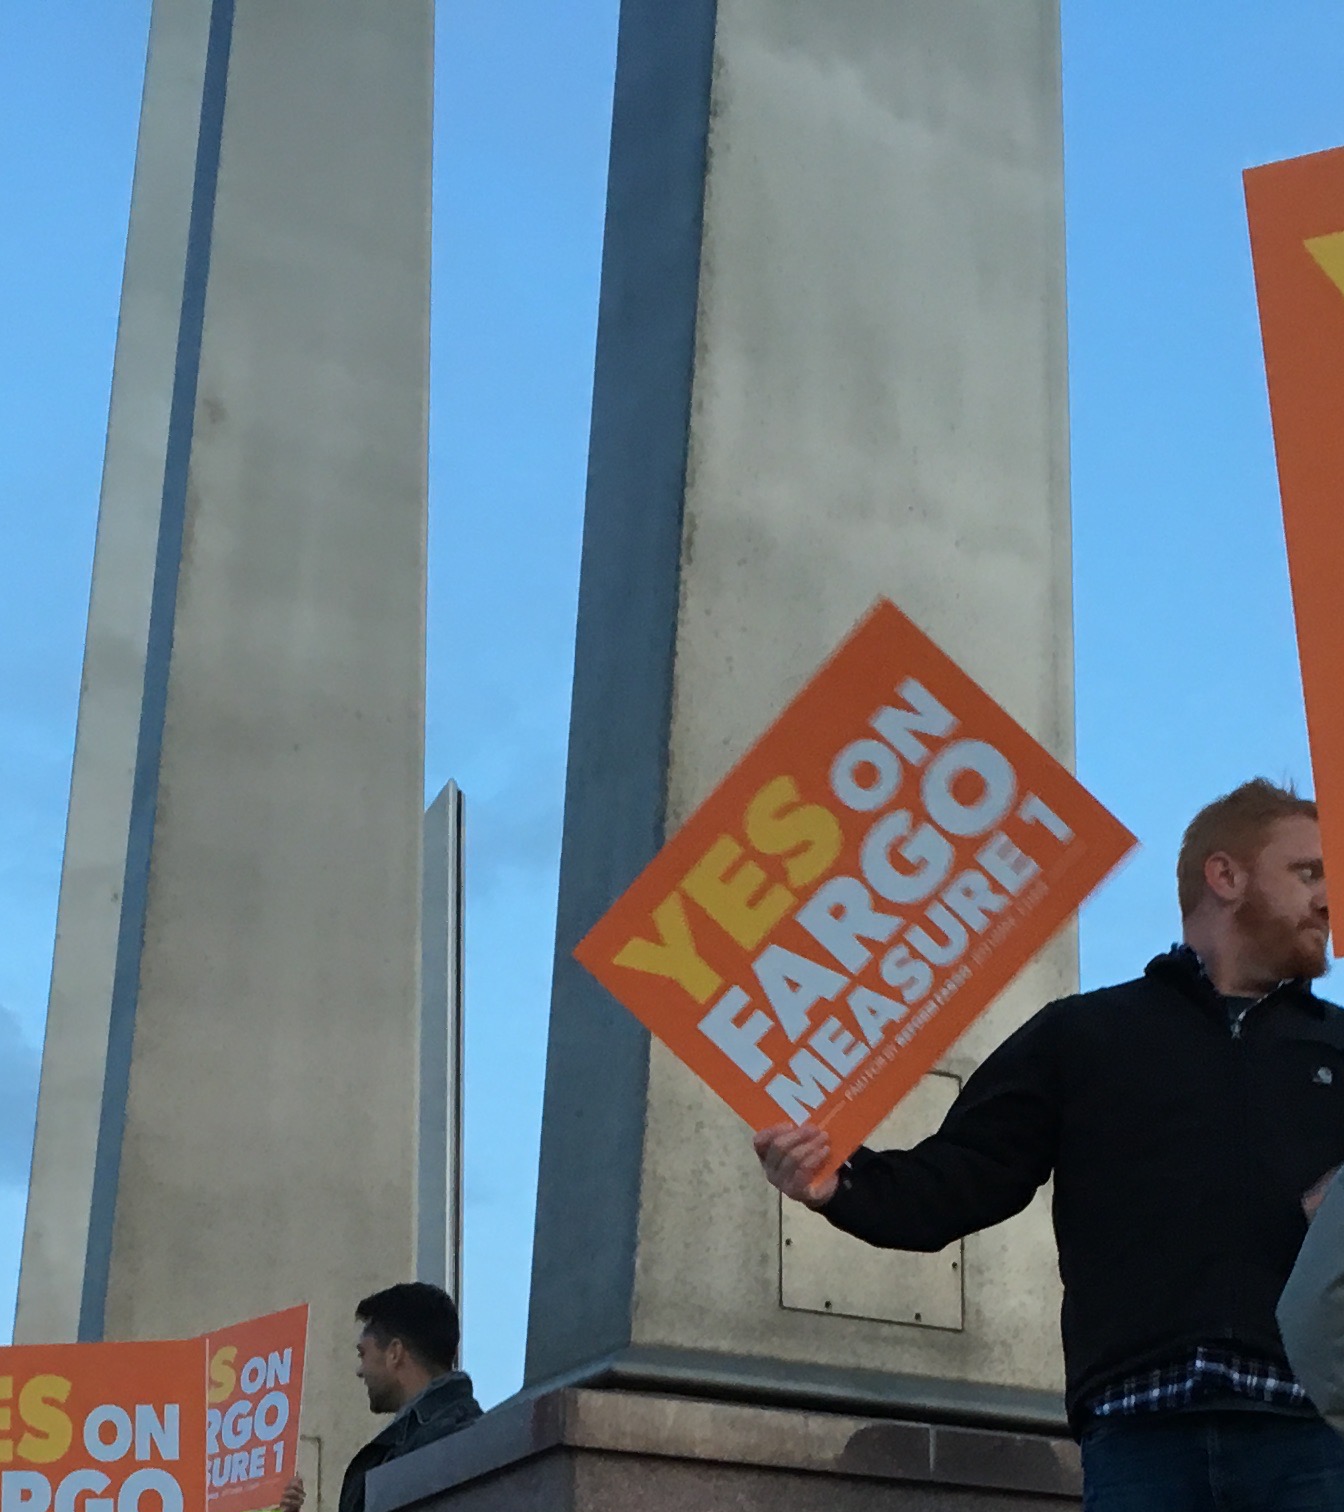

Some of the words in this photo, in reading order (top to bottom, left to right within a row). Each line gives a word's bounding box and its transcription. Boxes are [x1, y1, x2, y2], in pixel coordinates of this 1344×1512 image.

[613, 777, 841, 1004] YES
[831, 678, 957, 812] ON
[697, 739, 1016, 1083] FARGO
[765, 831, 1040, 1127] MEASURE
[1018, 793, 1073, 843] 1
[241, 1347, 292, 1394] ON
[83, 1404, 179, 1462] ON
[208, 1391, 290, 1454] RGO
[273, 1441, 284, 1473] 1
